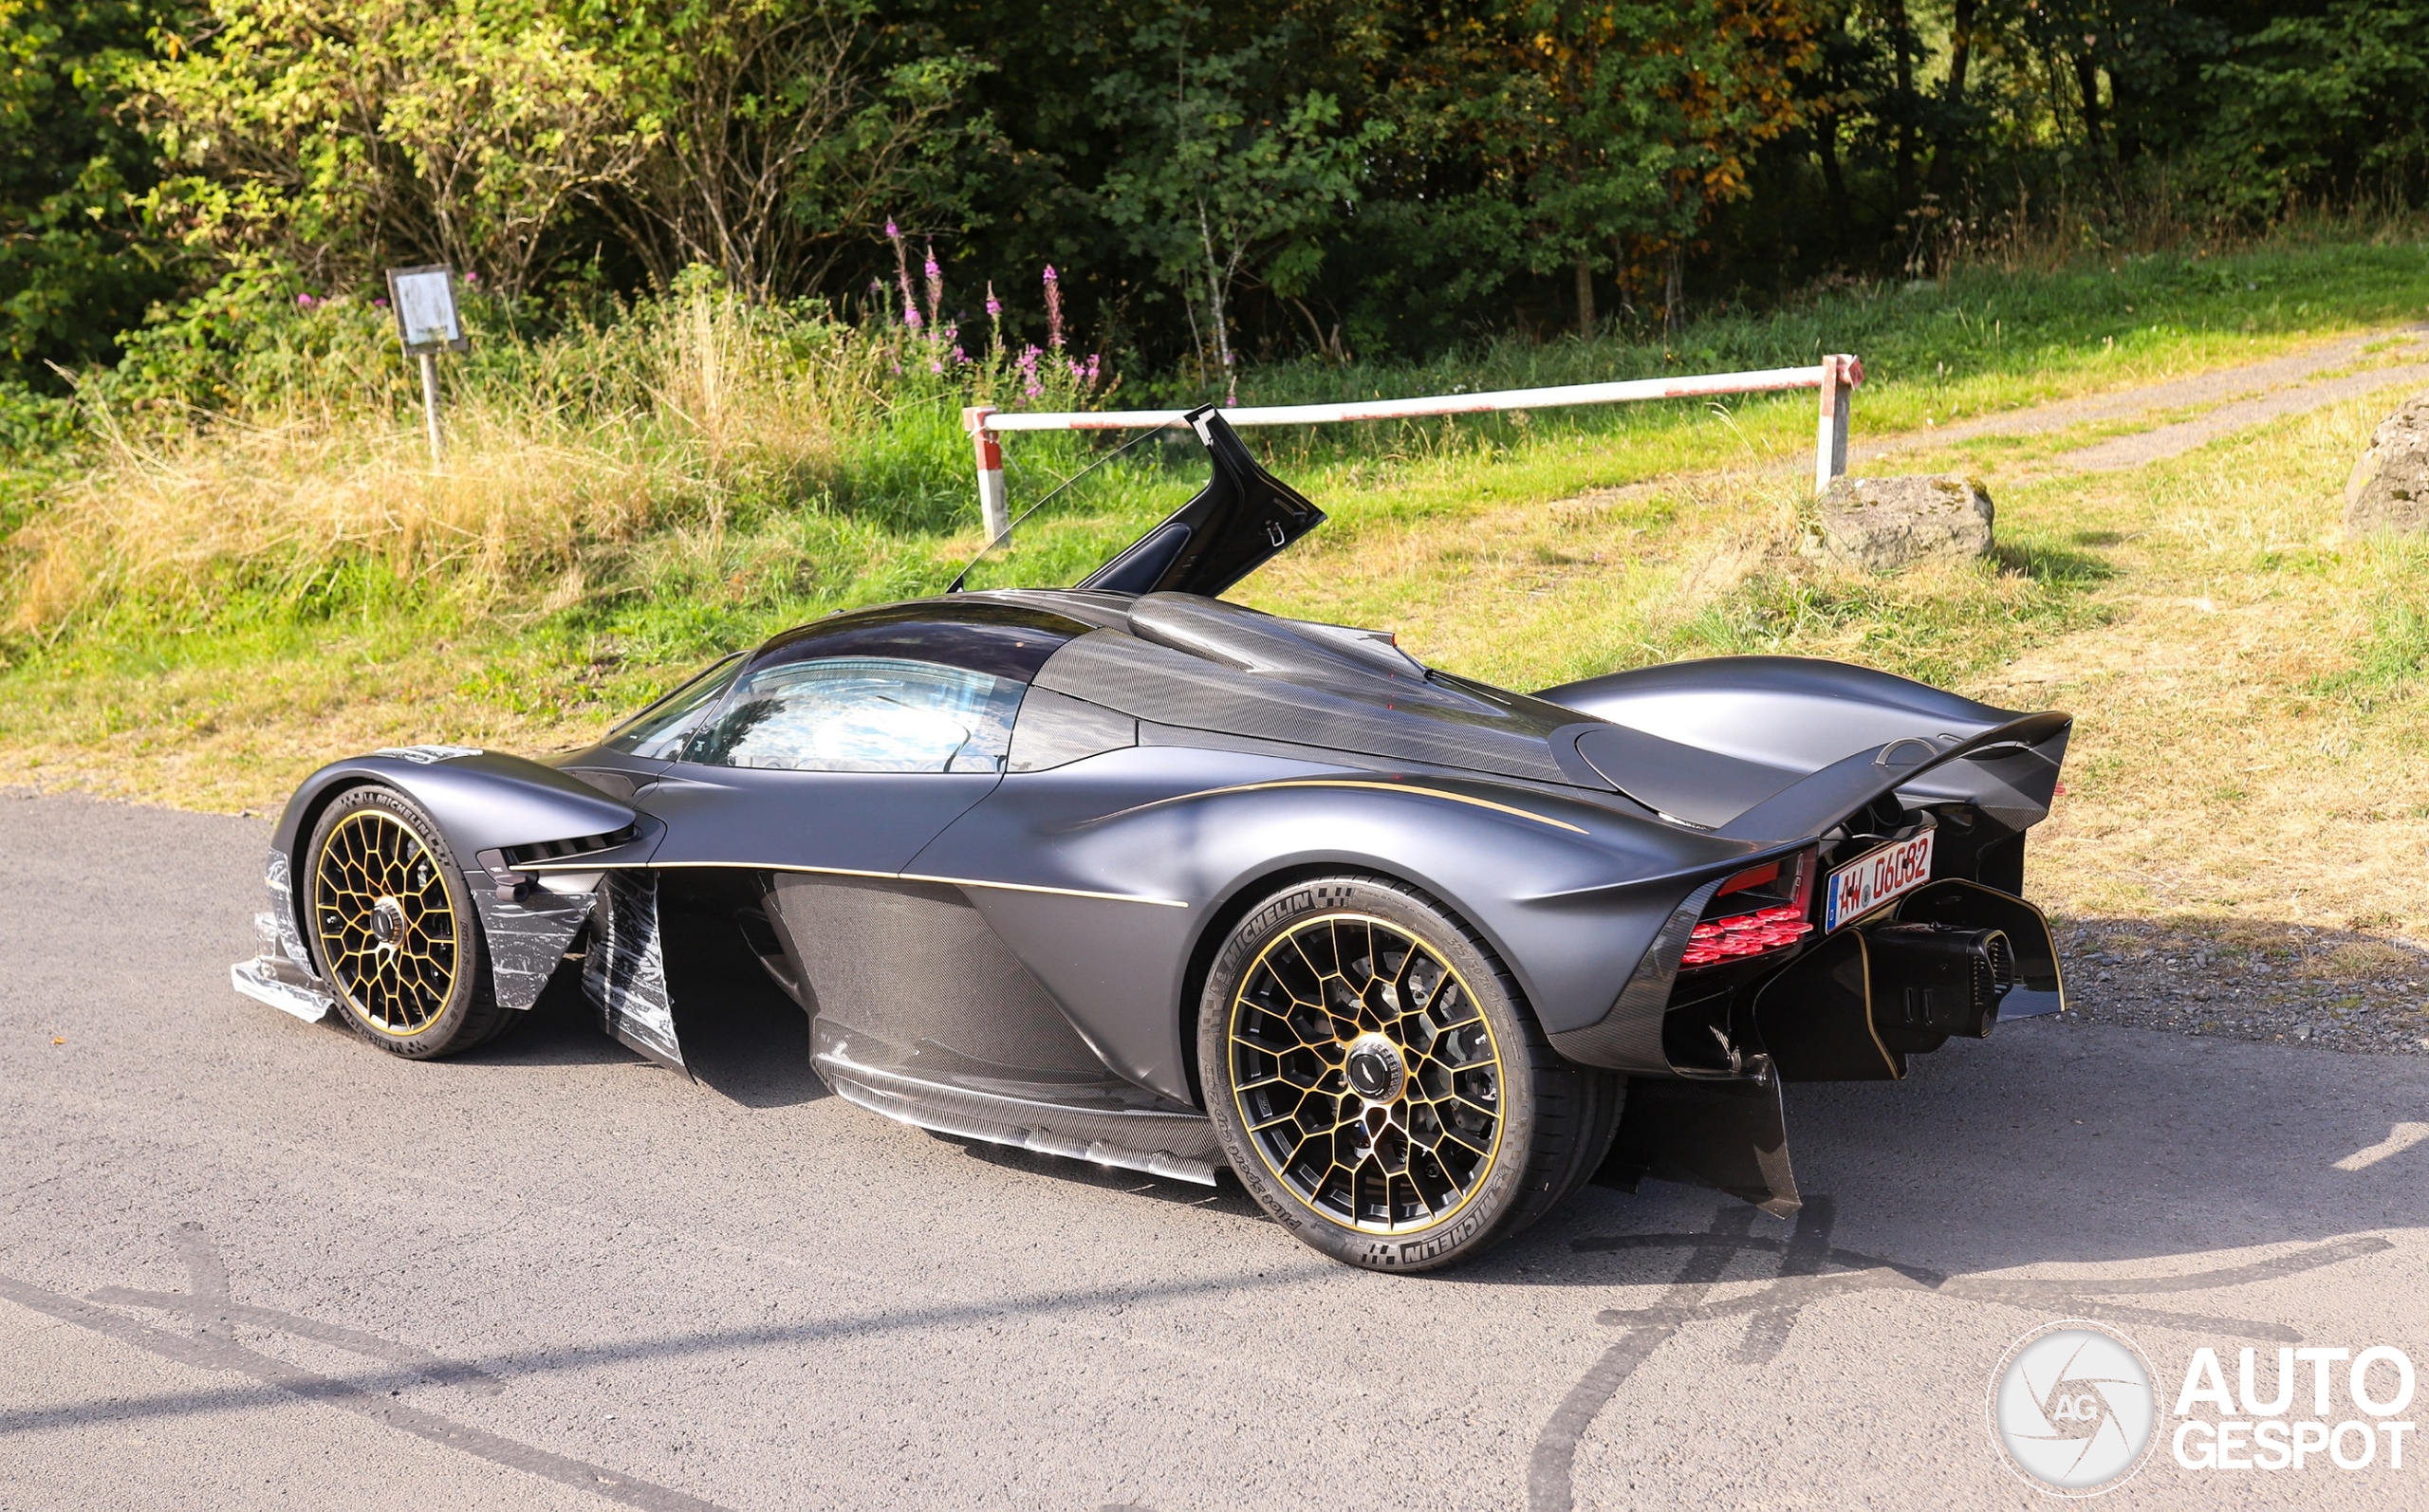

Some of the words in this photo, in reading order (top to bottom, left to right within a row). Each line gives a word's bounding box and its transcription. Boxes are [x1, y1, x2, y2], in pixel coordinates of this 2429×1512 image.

[376, 794, 430, 835] MICHELIN
[1873, 838, 1928, 899] 06082
[1222, 892, 1309, 968] MICHELIN
[1227, 1145, 1267, 1195] Sport
[1404, 1191, 1499, 1263] MICHELIN
